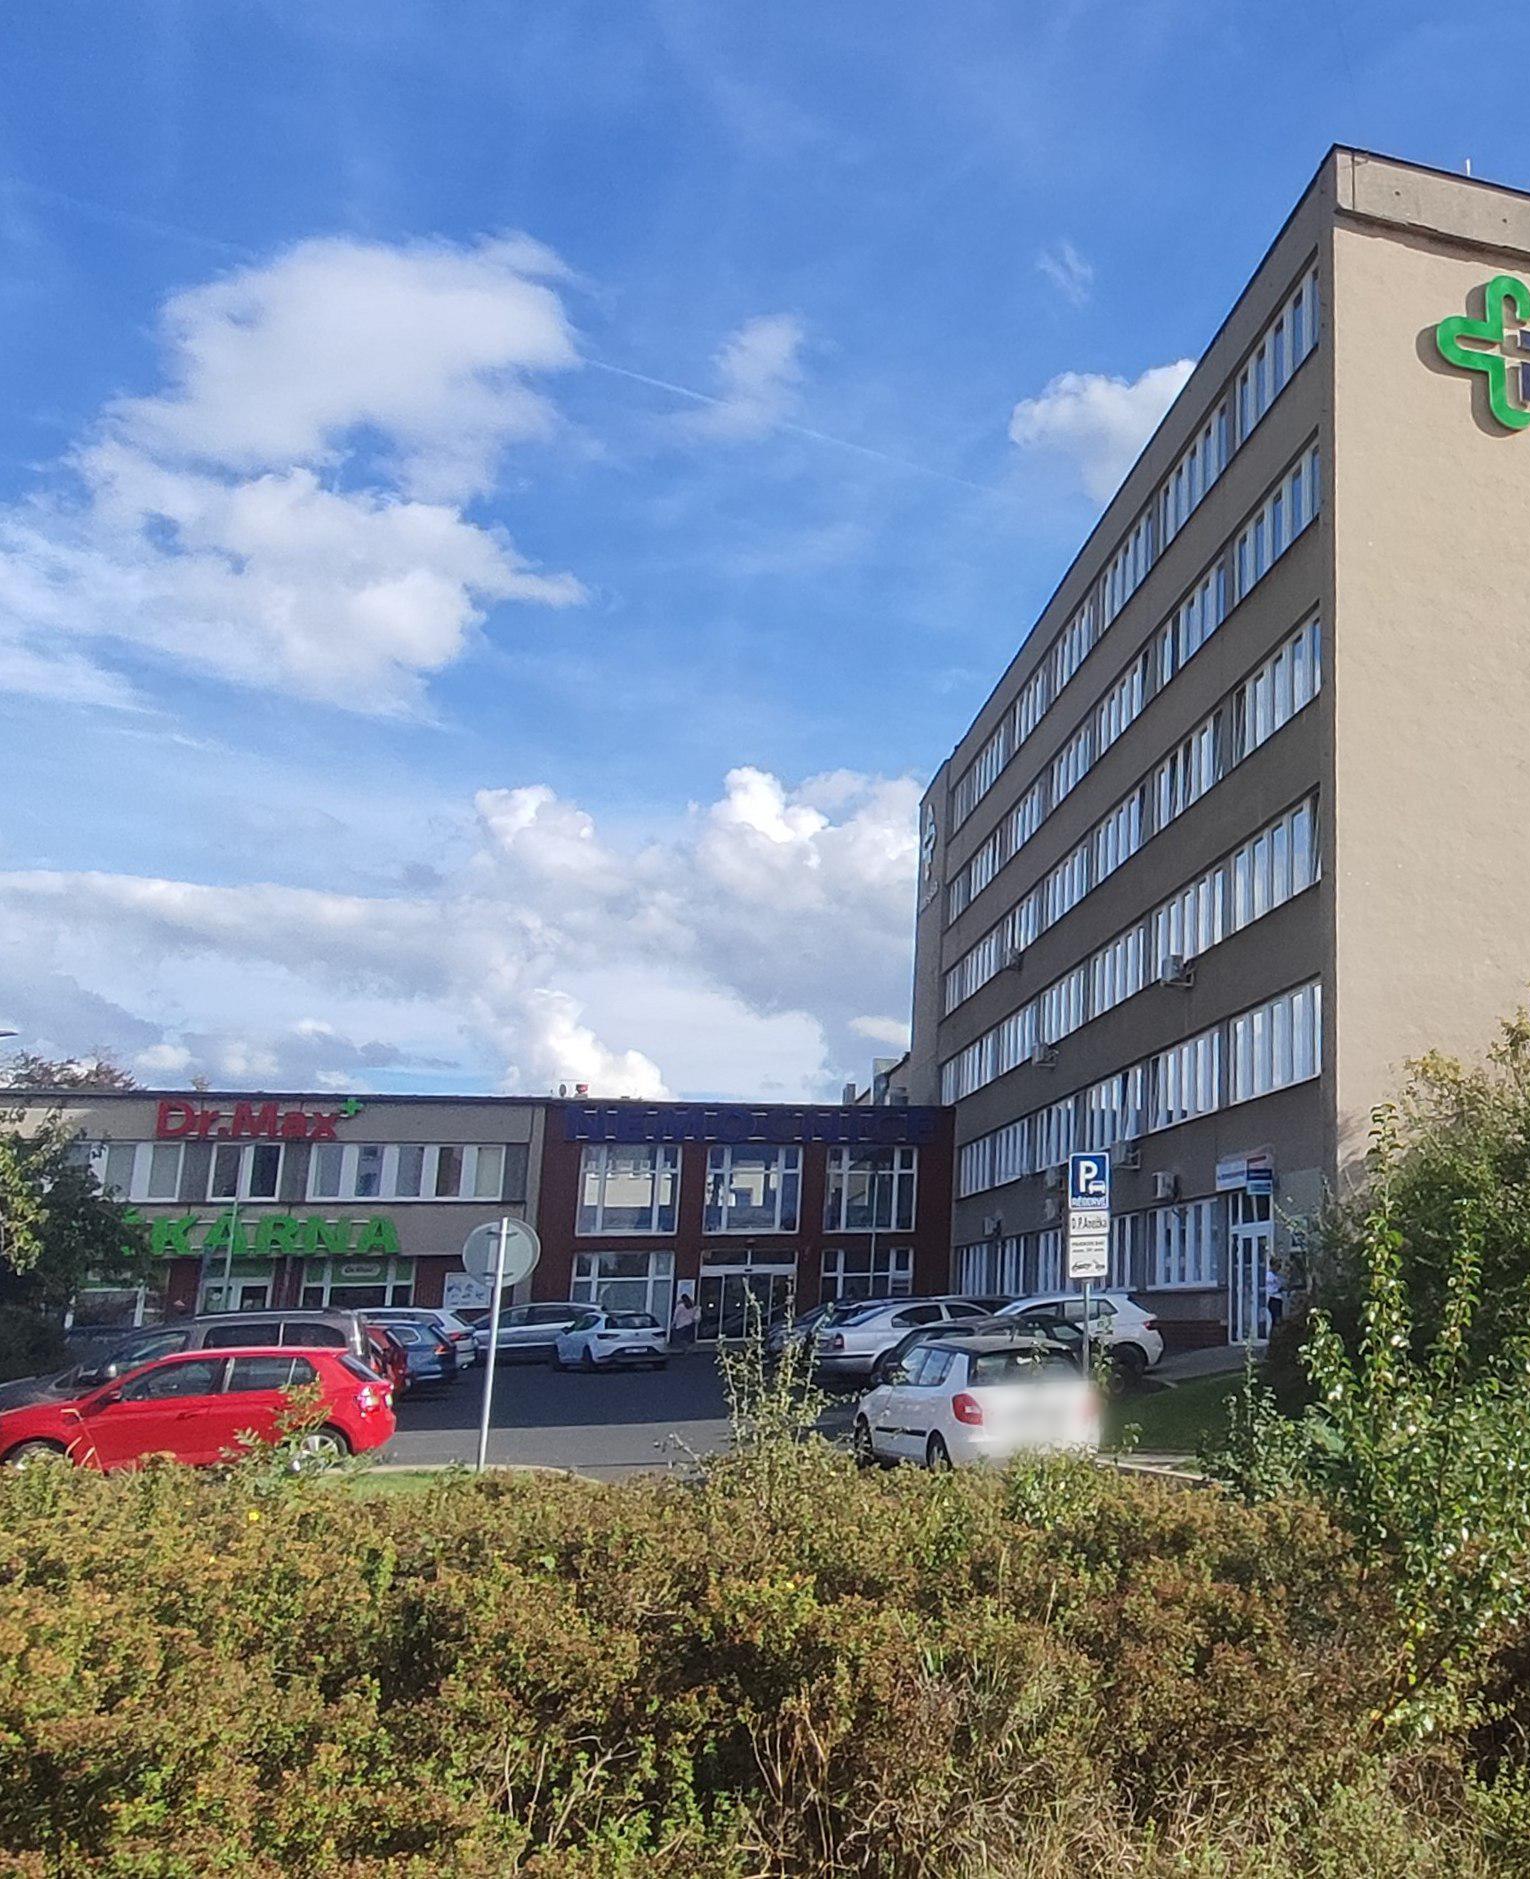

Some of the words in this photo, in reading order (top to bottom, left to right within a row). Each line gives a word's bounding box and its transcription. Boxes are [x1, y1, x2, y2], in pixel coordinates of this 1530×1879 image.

[156, 1100, 338, 1137] Dr.Max
[1079, 1160, 1098, 1193] P
[121, 1206, 398, 1255] KÁRNA
